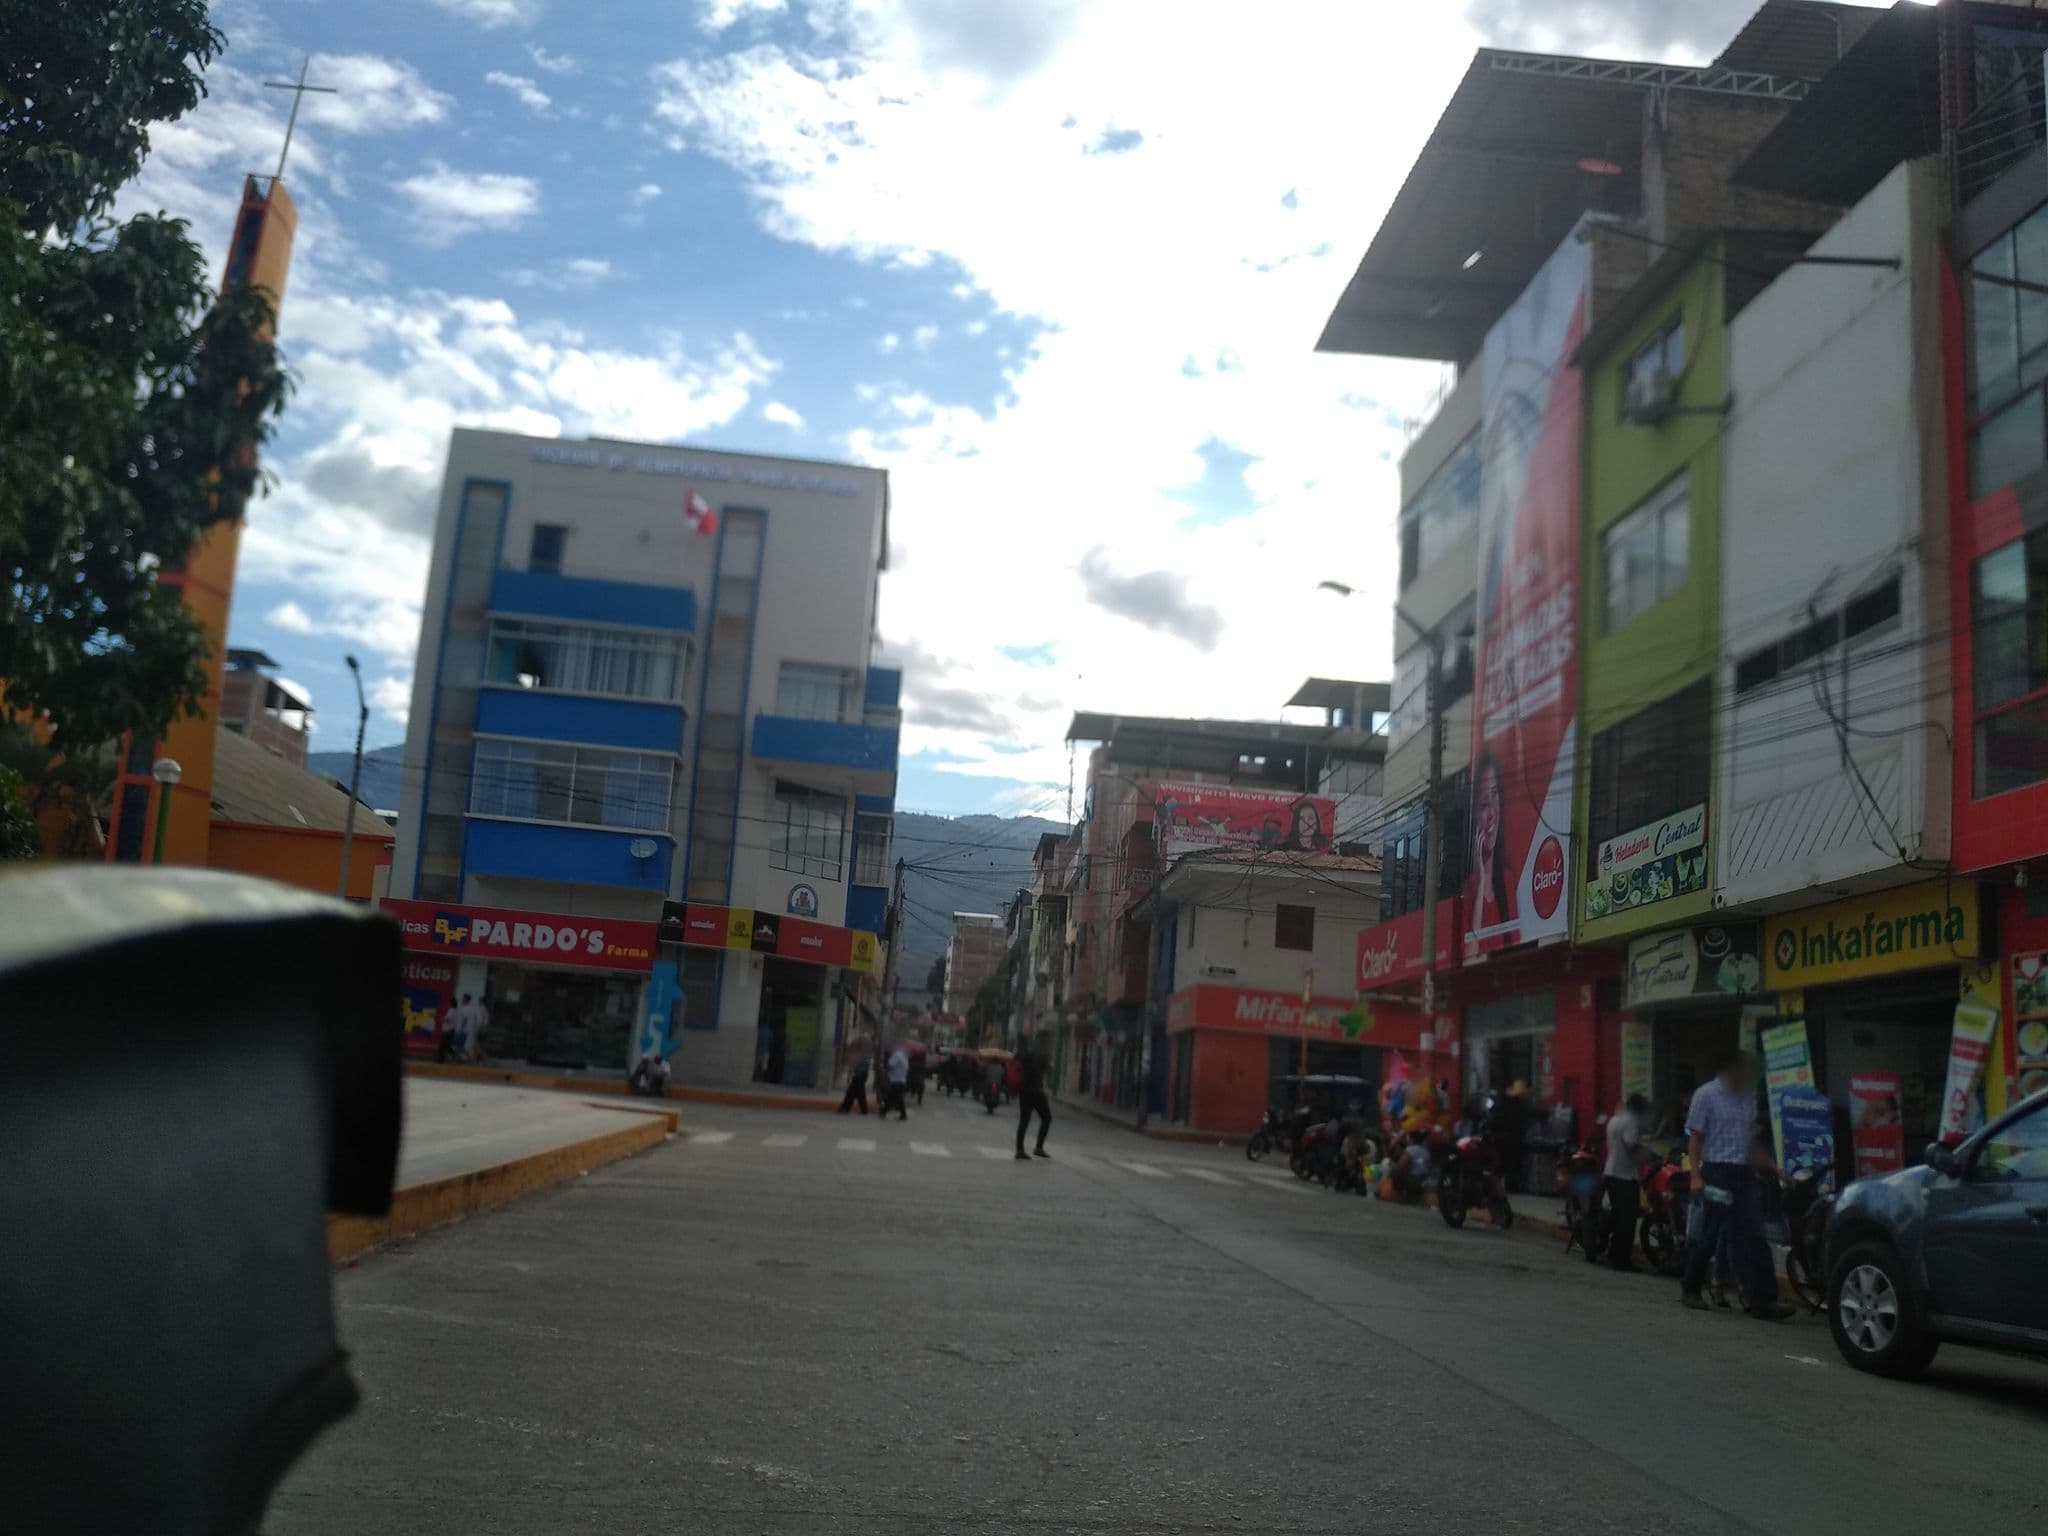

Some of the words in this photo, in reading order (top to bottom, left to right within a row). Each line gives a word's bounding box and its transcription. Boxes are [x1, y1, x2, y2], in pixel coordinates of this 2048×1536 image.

[1160, 783, 1227, 799] MOVIMIENTO
[1229, 791, 1266, 802] NUEVO
[1654, 813, 1702, 857] Central
[1534, 869, 1558, 891] Claro
[399, 920, 430, 934] icas
[471, 918, 605, 955] PARDO'S
[607, 944, 649, 958] Farma
[1801, 905, 1964, 969] Inkafarma
[1361, 946, 1393, 980] Claro
